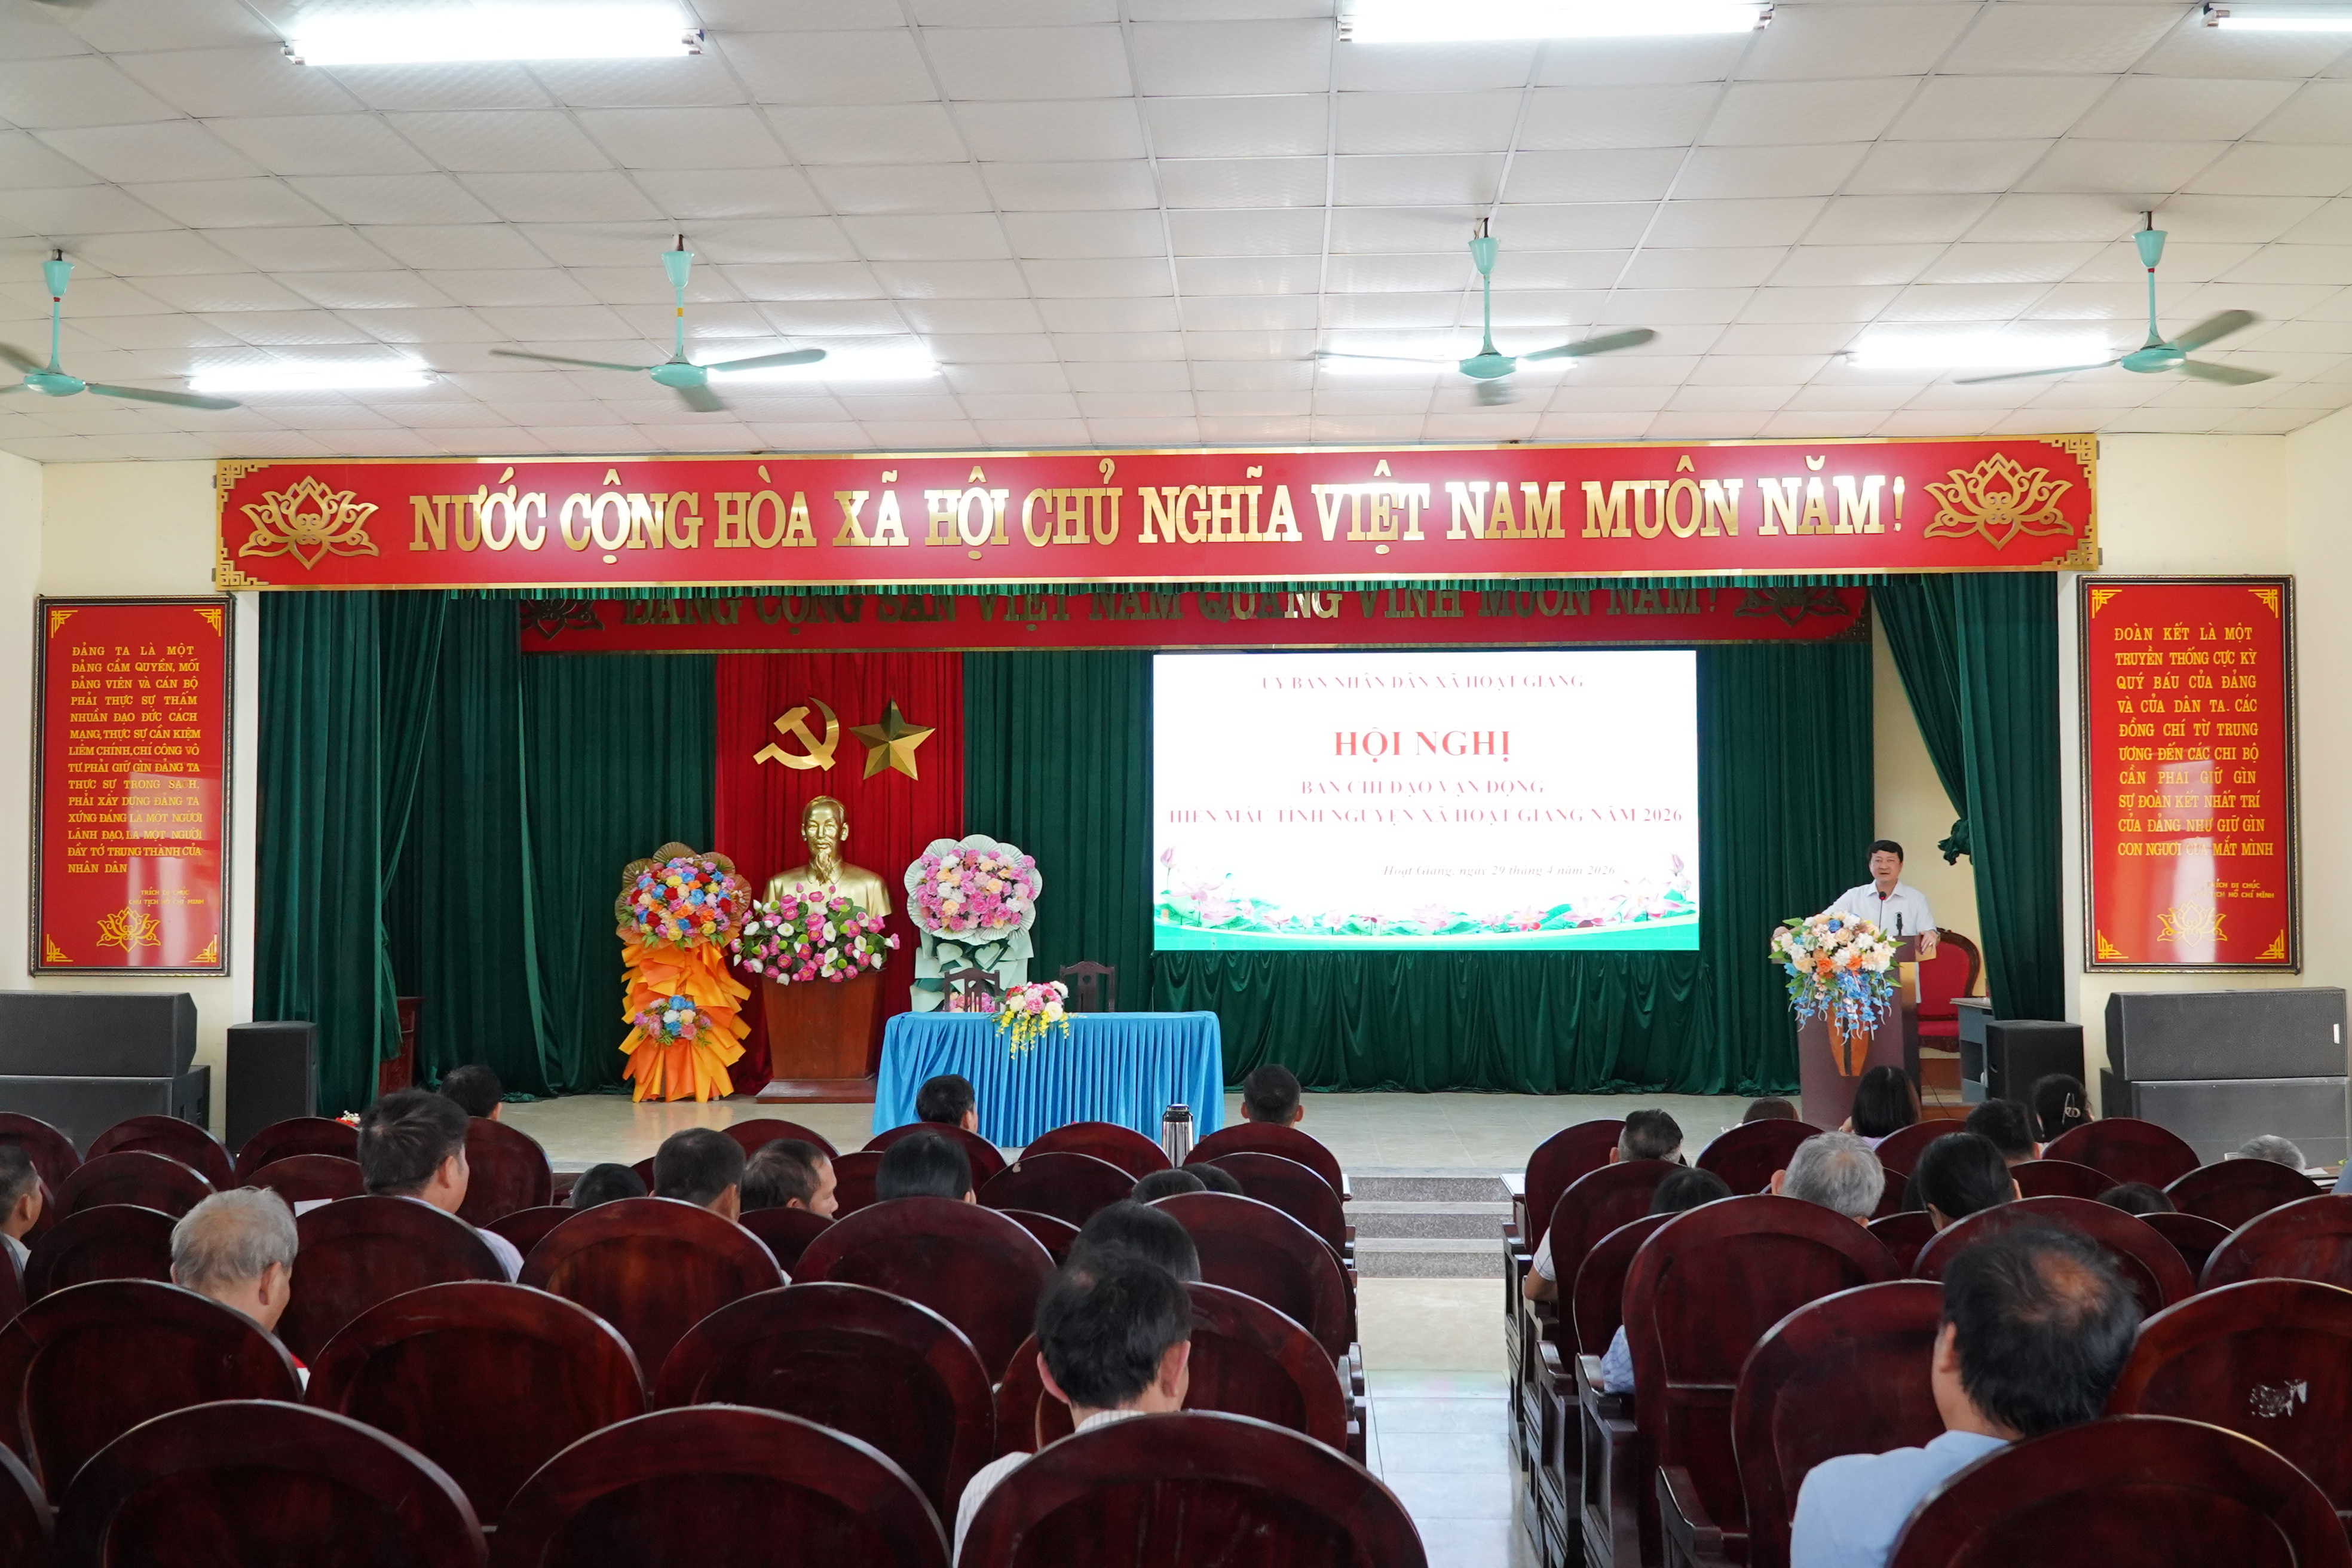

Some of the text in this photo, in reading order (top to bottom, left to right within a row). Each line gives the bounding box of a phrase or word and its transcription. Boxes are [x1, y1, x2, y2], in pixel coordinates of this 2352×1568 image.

[409, 467, 546, 553] NƯỚC
[559, 469, 704, 566] CỘNG
[713, 466, 817, 549] HÒA
[832, 470, 909, 548] XÃ
[925, 466, 1010, 561] HỘI
[1022, 457, 1123, 547] CHỦ
[1138, 466, 1302, 545] NGHĨA
[1310, 459, 1430, 556] VIỆT
[1446, 480, 1566, 540] NAM
[1582, 456, 1742, 540] MUÔN
[2114, 621, 2252, 643] ĐOÀN KẾT LÀ MỘT
[72, 642, 194, 657] ĐẢNG TA LÀ MỘT
[2115, 645, 2257, 667] TRUYỀN THỐNG CỰC KỲ
[72, 659, 102, 672] ĐẢNG
[107, 658, 130, 672] CẦM
[72, 675, 198, 690] ĐẢNG VIÊN VÀ CÁN BỘ
[1293, 677, 1328, 689] BAN
[1334, 672, 1385, 688] NHÂN
[1392, 672, 1428, 688] DÂN
[1436, 673, 1459, 688] XÃ
[1467, 675, 1517, 690] HOẠT
[1524, 675, 1583, 687] GIANG
[2117, 669, 2256, 690] QUÝ BÁU CỦA ĐẢNG
[71, 691, 197, 708] PHẢI THỰC SỰ THẤM
[2117, 696, 2133, 713] VÀ
[2140, 693, 2165, 713] CỦA
[2174, 695, 2200, 712] DÂN
[2235, 694, 2257, 712] CÁC
[70, 708, 197, 725] NHUẦN ĐẠO ĐỨC CÁCH
[103, 728, 130, 741] THỰC
[134, 728, 148, 741] SỰ
[149, 724, 170, 739] CẦN
[173, 727, 201, 741] KIỆM
[2119, 717, 2258, 737] ĐỒNG CHÍ TỪ TRUNG
[68, 743, 94, 755] LIÊM
[154, 743, 182, 755] CÔNG
[185, 743, 199, 755] VÔ
[1334, 727, 1510, 762] HỘI NGHỊ
[2119, 742, 2259, 763] ƯƠNG ĐẾN CÁC CHI BỘ
[84, 758, 109, 773] PHẢI
[133, 760, 152, 772] GÌN
[155, 758, 184, 772] ĐẢNG
[187, 763, 200, 771] TA
[2120, 764, 2256, 785] CẦN PHẢI GIỮ GÌN
[68, 779, 96, 792] THỰC
[103, 779, 117, 792] SỰ
[123, 780, 160, 789] TRONG
[1302, 781, 1340, 794] BAN
[68, 792, 94, 806] PHẢI
[154, 792, 183, 806] ĐẢNG
[186, 797, 199, 806] TA
[2119, 790, 2261, 811] SỰ ĐOÀN KẾT NHẤT TRÍ
[68, 809, 169, 825] XỨNG ĐÁNG LÀ MỘT
[1422, 806, 1447, 822] XÃ
[1456, 808, 1511, 826] HOẠT
[1518, 808, 1583, 822] GIANG
[1591, 806, 1635, 822] NĂM
[1643, 808, 1682, 822] 2026
[2118, 813, 2265, 832] CỦA ĐẢNG NHƯ GIỮ GÌN
[68, 828, 97, 840] LÃNH
[126, 828, 139, 840] LÀ
[143, 828, 166, 841] MỘT
[68, 842, 202, 856] ĐẦY TỚ TRUNG THÀNH CỦA
[2118, 843, 2142, 856] CON
[2212, 835, 2237, 856] MẮT
[2241, 839, 2274, 856] MÌNH
[68, 860, 128, 872] NHÂN DÂN
[1492, 865, 1505, 875] 29
[1587, 865, 1615, 875] 2026
